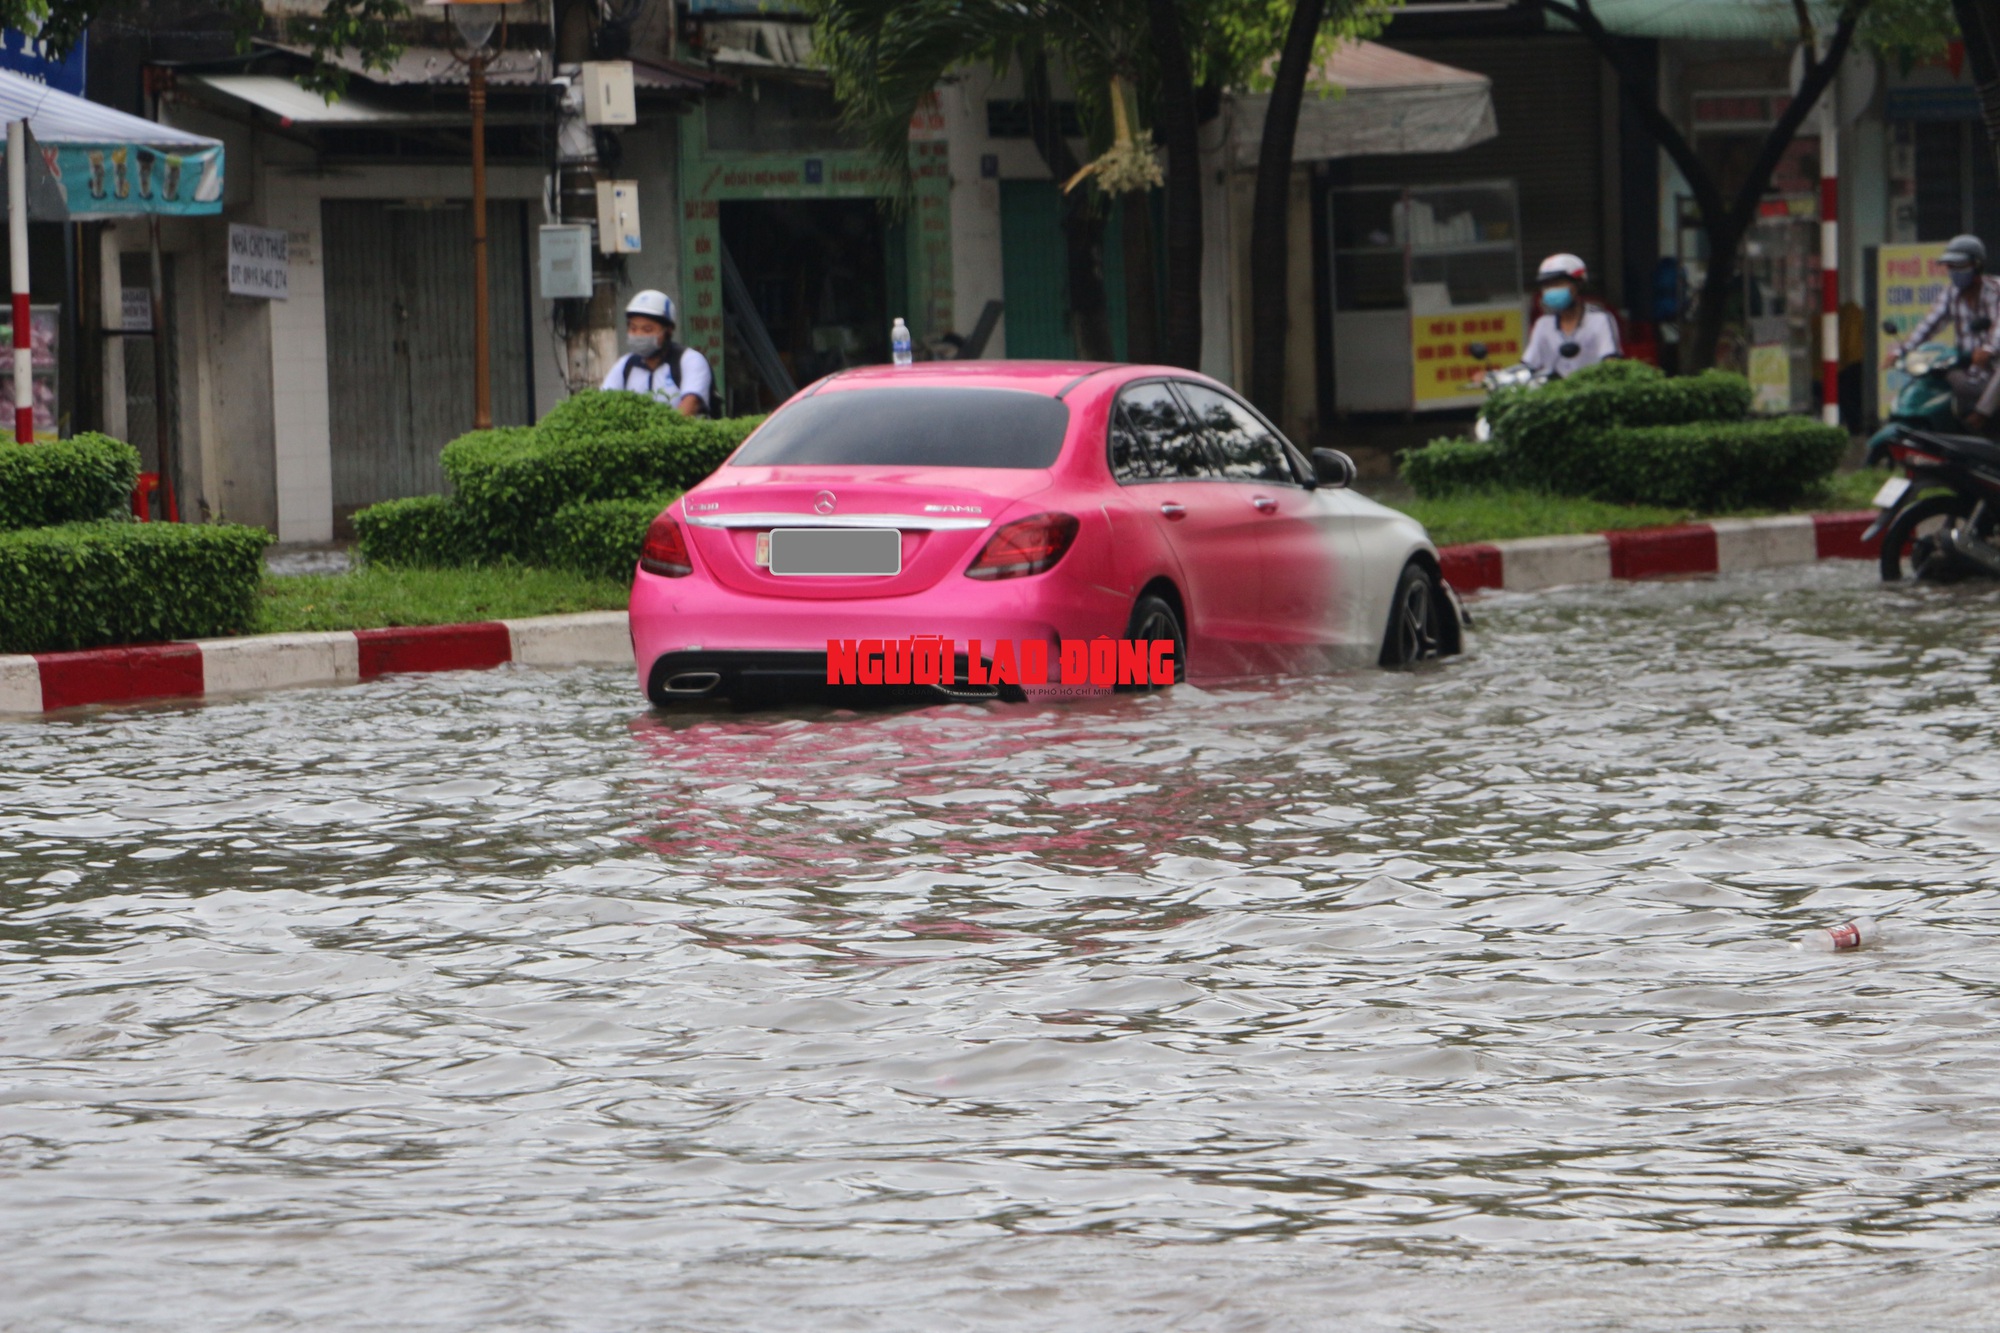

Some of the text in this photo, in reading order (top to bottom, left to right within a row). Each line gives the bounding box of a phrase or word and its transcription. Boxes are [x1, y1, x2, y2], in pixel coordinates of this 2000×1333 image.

[231, 228, 248, 256] NHÀ
[250, 234, 264, 258] CHO
[265, 233, 287, 262] THUÊ
[942, 504, 983, 514] AMG
